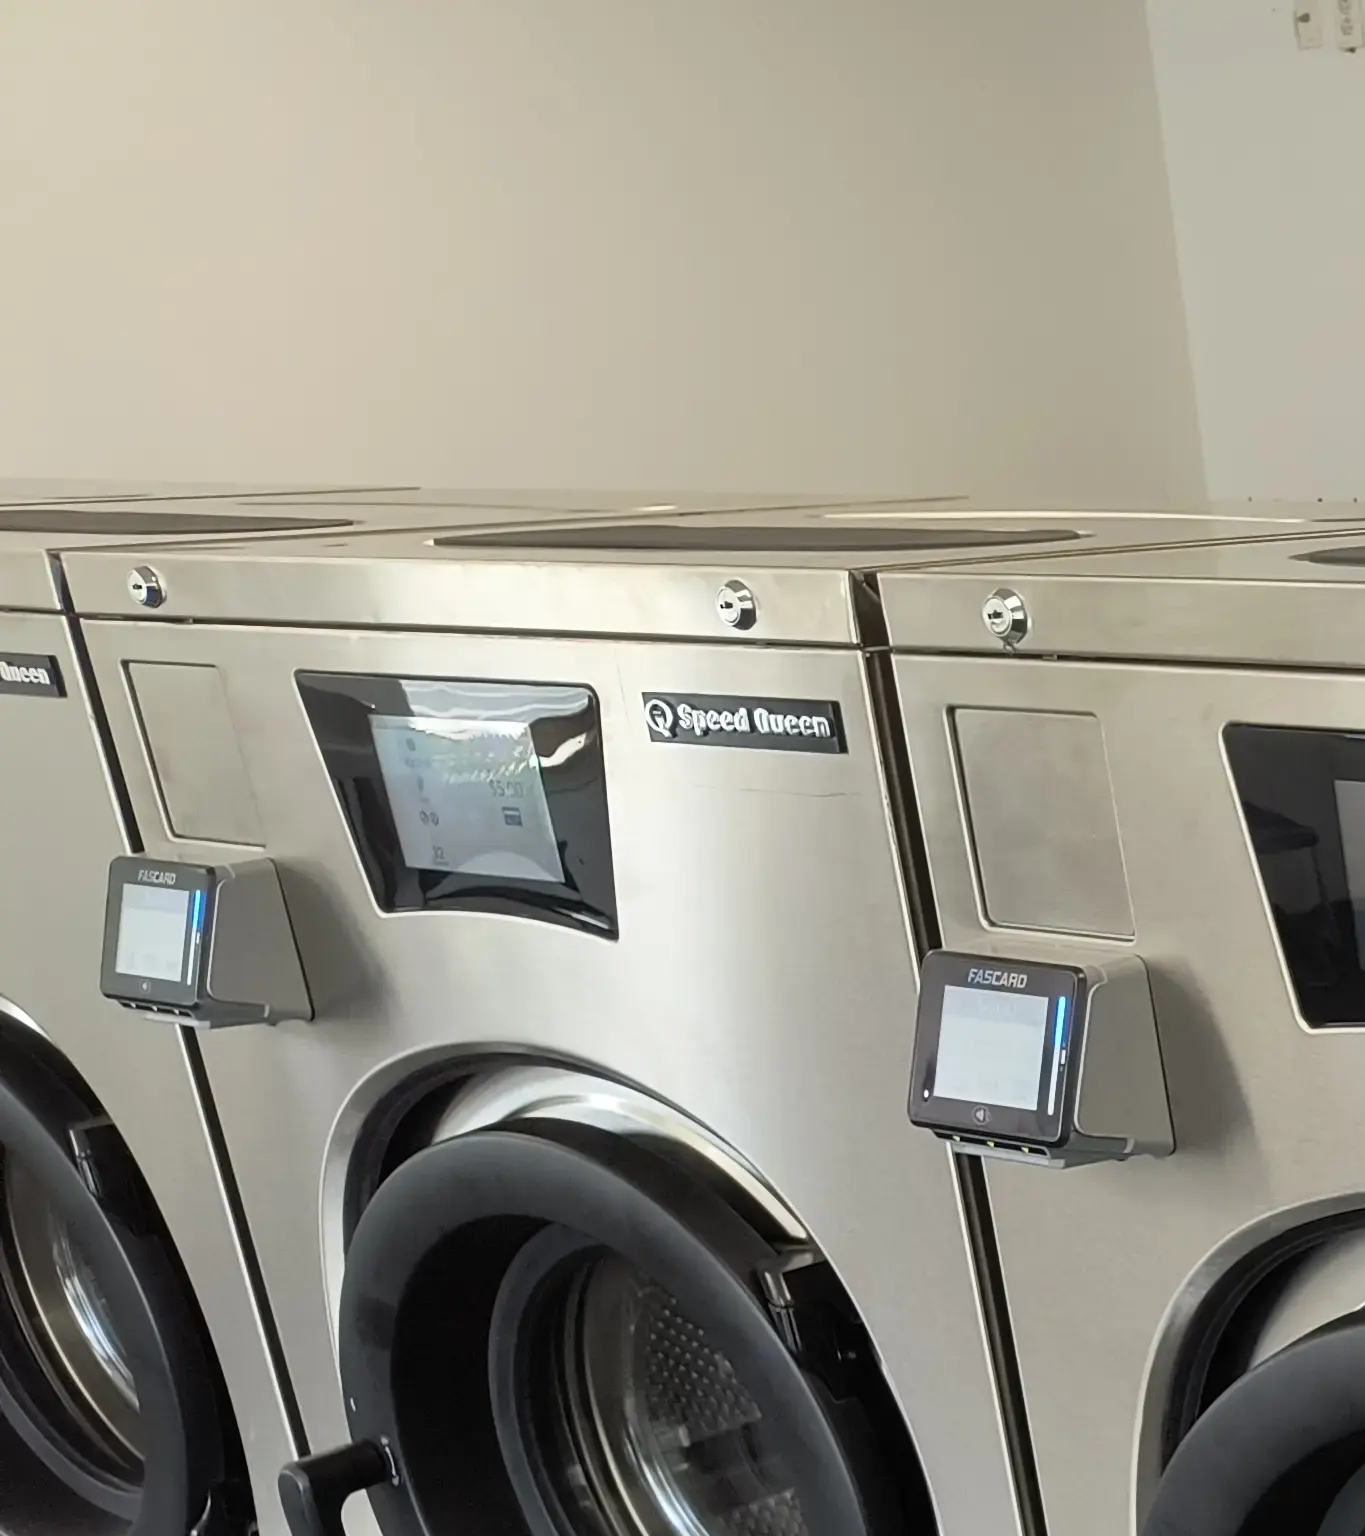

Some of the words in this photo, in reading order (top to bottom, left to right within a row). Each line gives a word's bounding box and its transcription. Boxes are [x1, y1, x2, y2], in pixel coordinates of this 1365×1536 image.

[677, 703, 750, 736] Speed
[754, 707, 831, 738] Queen
[138, 870, 177, 885] FASCARD
[967, 968, 1028, 988] FASCARD
